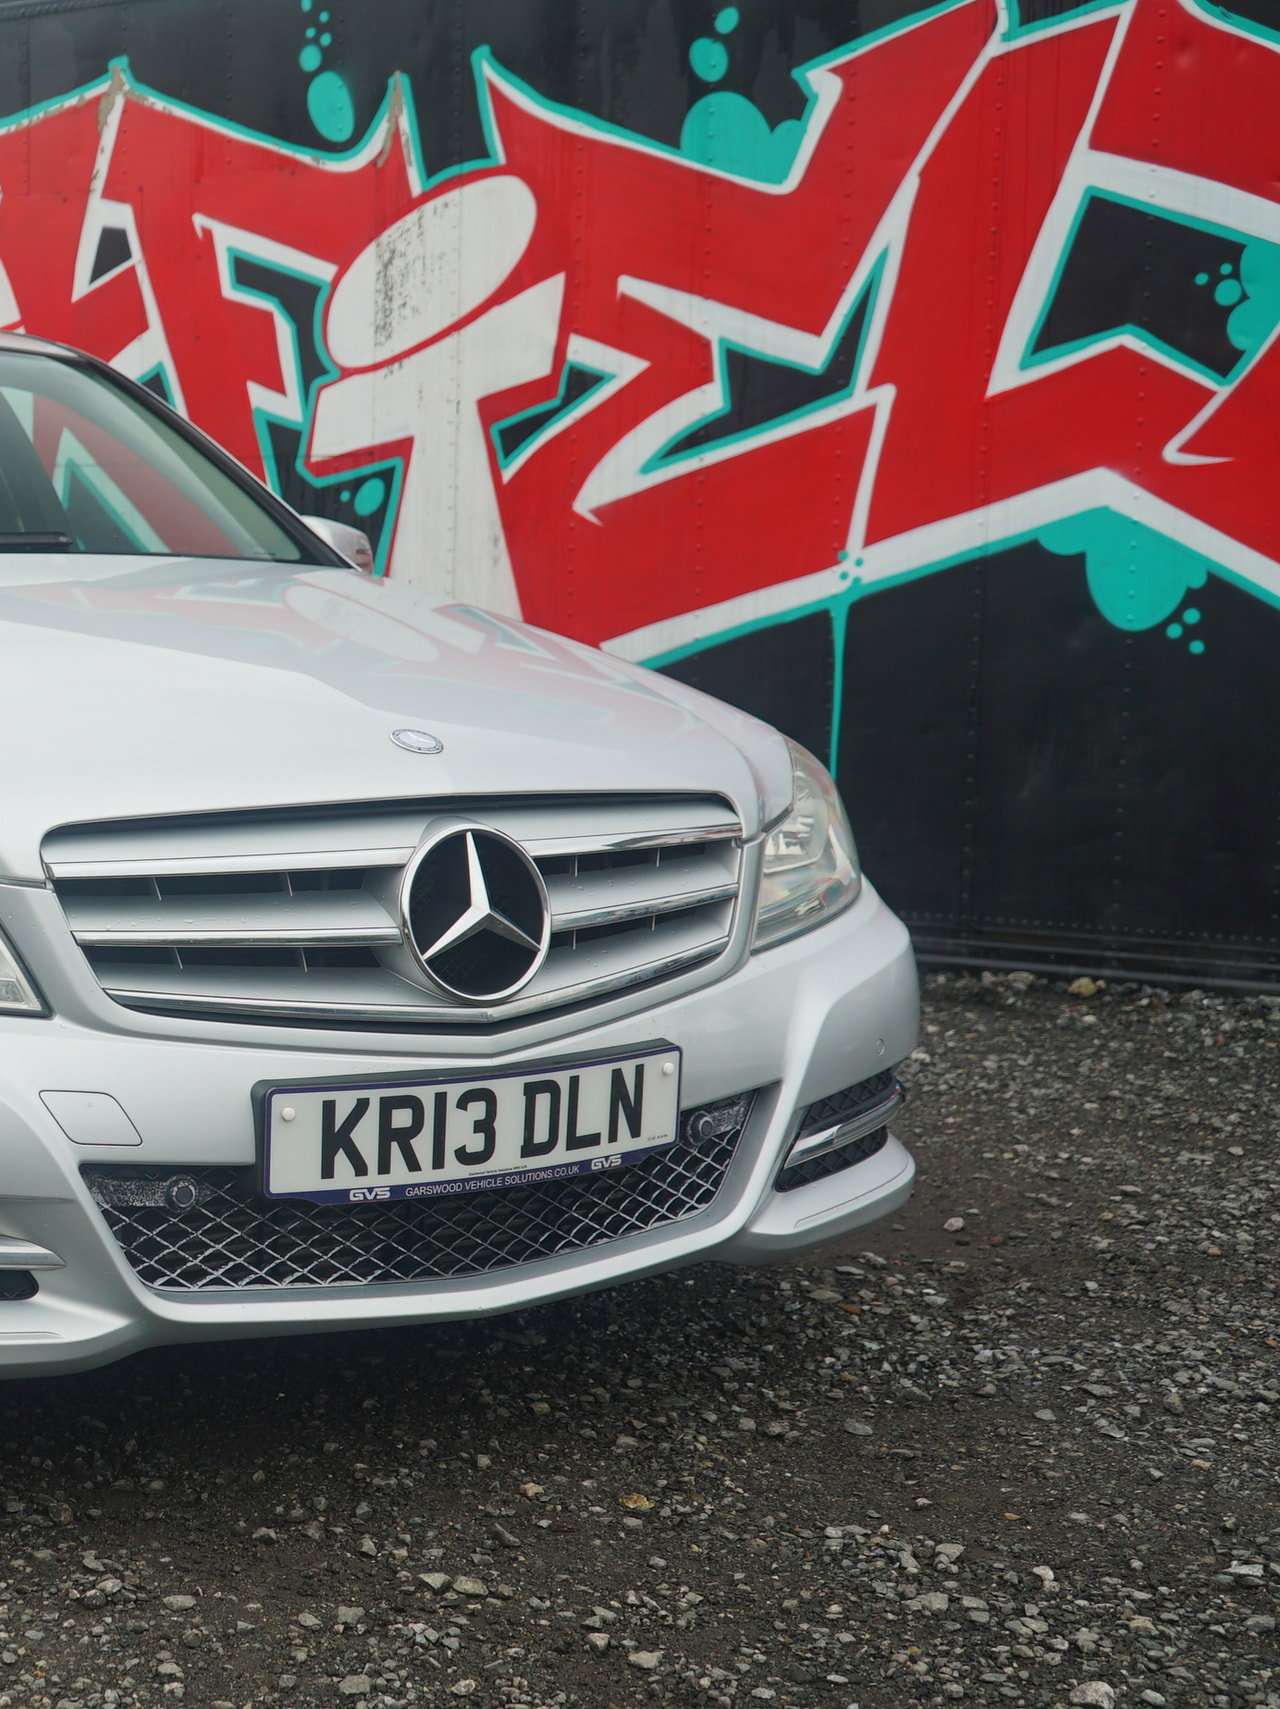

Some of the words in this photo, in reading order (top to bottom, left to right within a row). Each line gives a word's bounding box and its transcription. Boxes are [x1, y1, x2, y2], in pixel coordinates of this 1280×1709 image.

[320, 1086, 497, 1180] KR13
[520, 1063, 645, 1160] DLN
[591, 1153, 622, 1171] GVS
[405, 1182, 462, 1197] GARSWOOD
[465, 1176, 503, 1191] VEHICLE
[504, 1164, 580, 1187] SOLUTIONS.CO.UK
[349, 1187, 391, 1201] GVS
